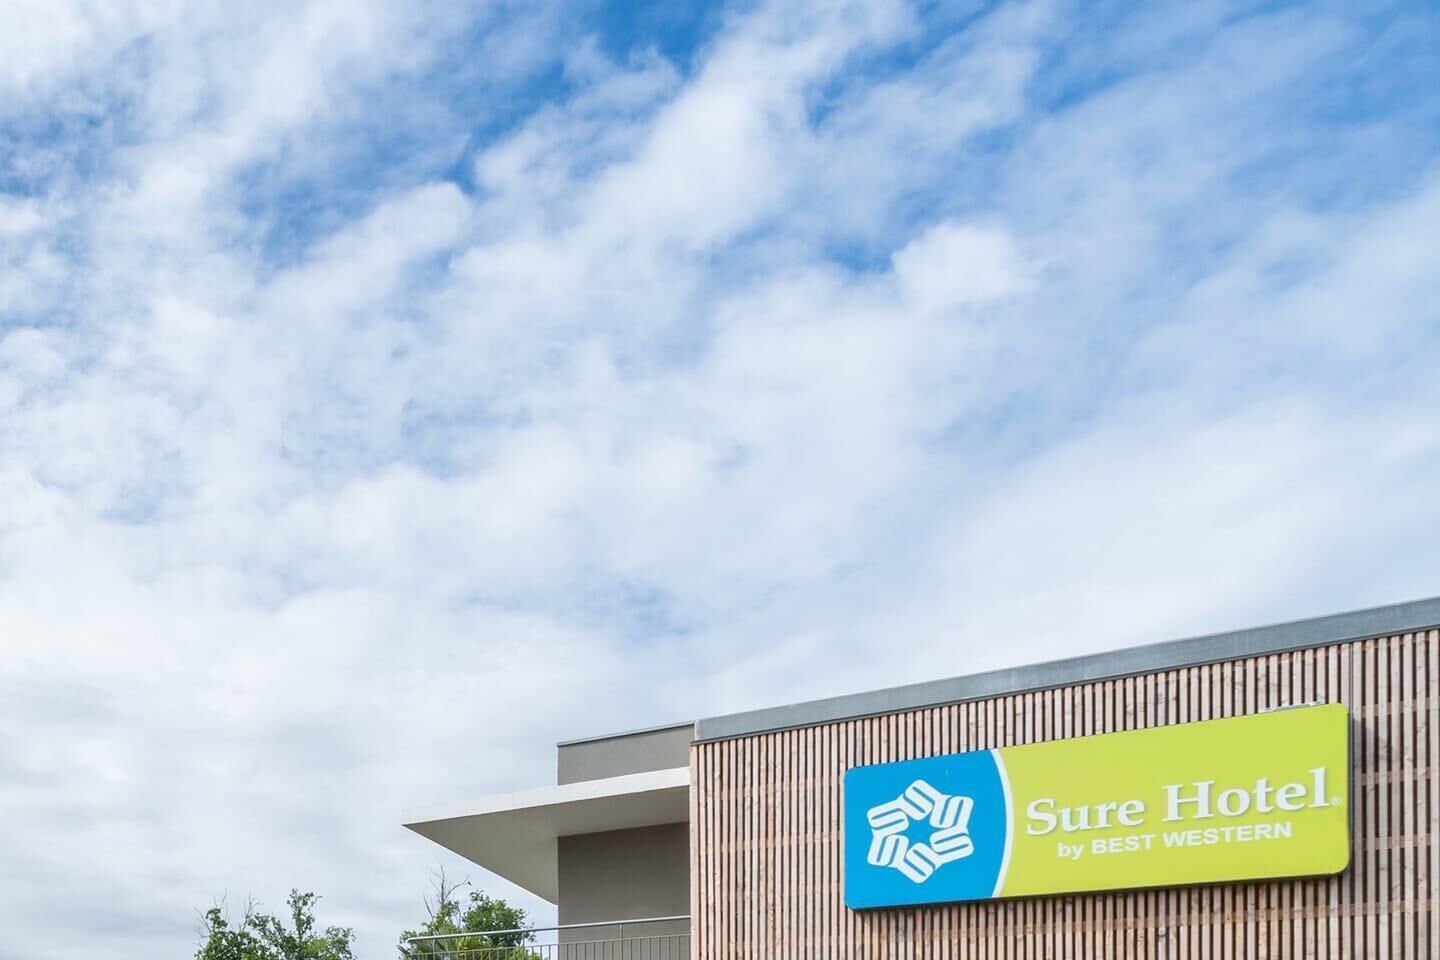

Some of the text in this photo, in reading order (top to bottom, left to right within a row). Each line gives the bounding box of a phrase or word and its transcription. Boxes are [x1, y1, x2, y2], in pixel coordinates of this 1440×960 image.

[1025, 766, 1331, 837] Sure Hotel
[1056, 820, 1293, 861] by BEST WESTERN
